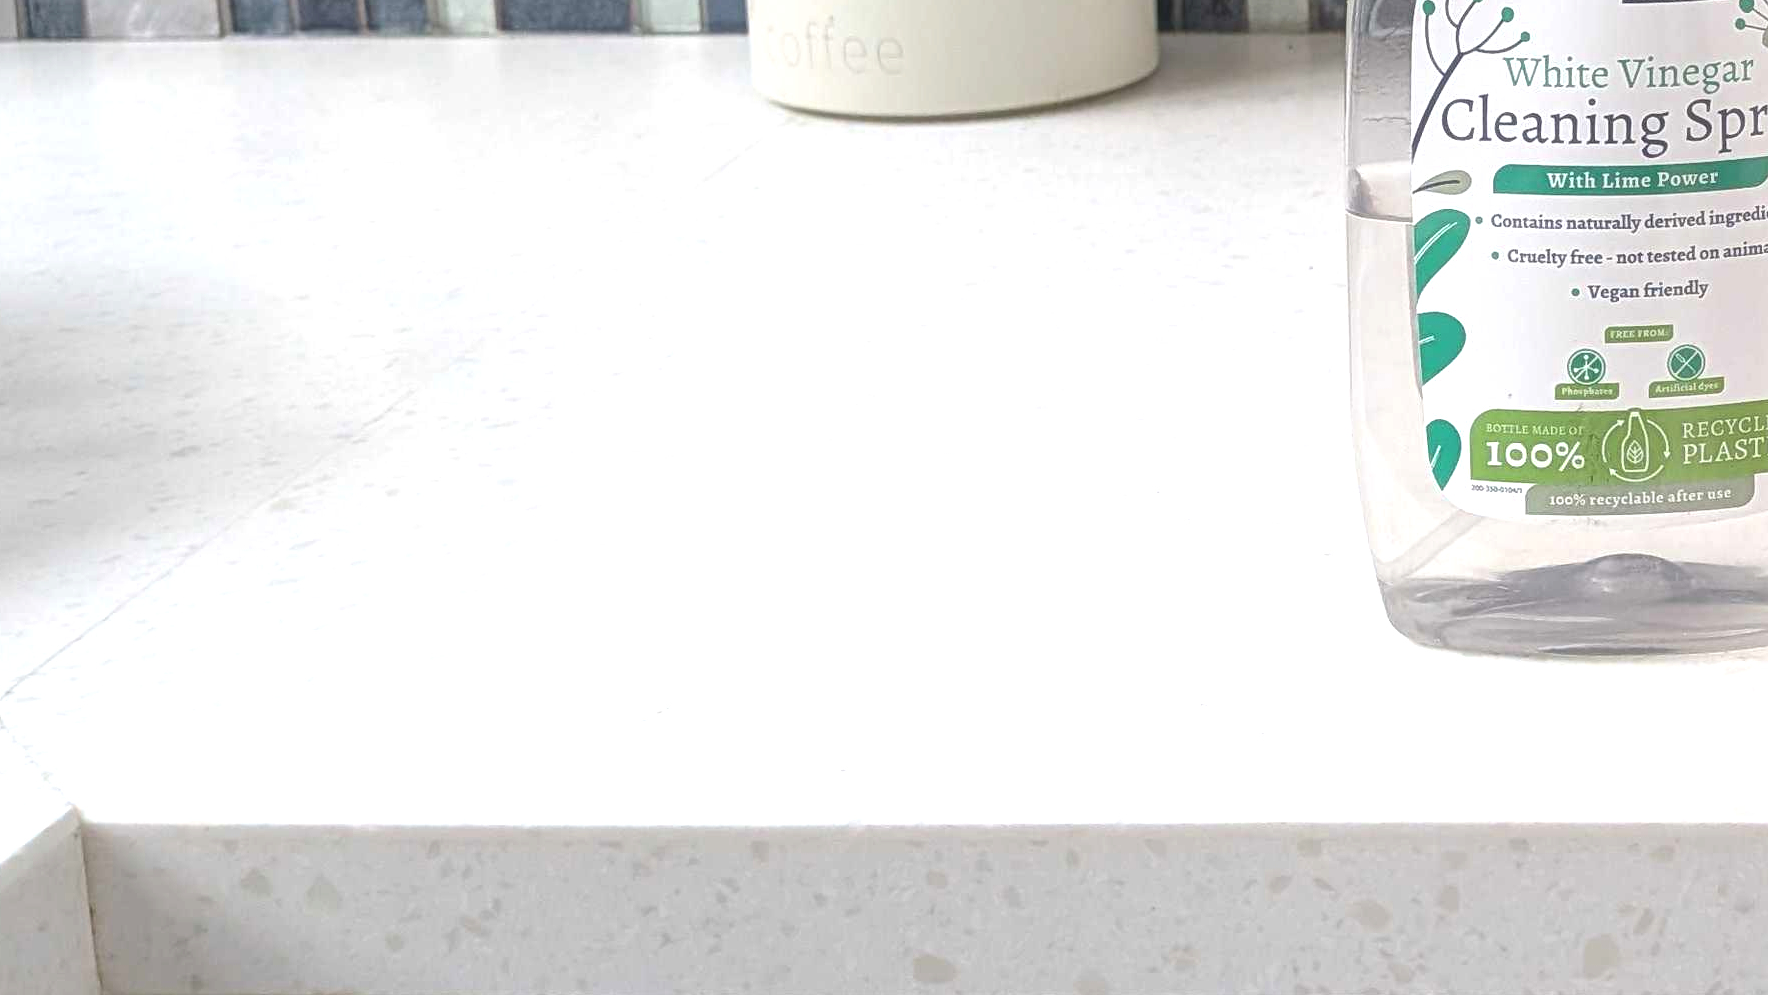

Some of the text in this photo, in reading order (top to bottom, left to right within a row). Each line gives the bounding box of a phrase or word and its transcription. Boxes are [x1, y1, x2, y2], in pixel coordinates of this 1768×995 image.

[1504, 55, 1754, 95] White Vinegar
[1441, 93, 1670, 159] Cleaning
[1546, 169, 1719, 189] With Lime Power
[1491, 213, 1563, 230] Contains
[1566, 214, 1641, 234] naturally
[1644, 210, 1707, 229] derived
[1507, 248, 1567, 269] Cruelty
[1570, 248, 1603, 265] free
[1616, 252, 1645, 265] not
[1647, 245, 1696, 264] tested
[1699, 248, 1720, 260] on
[1587, 279, 1709, 303] Vegan friendly
[1610, 330, 1635, 339] FREE
[1654, 381, 1719, 394] Artificial dyes
[1485, 423, 1530, 435] BOTTLE
[1531, 425, 1566, 436] MADE
[1485, 441, 1586, 472] 100%
[1549, 488, 1732, 508] 100% recyclable after use
